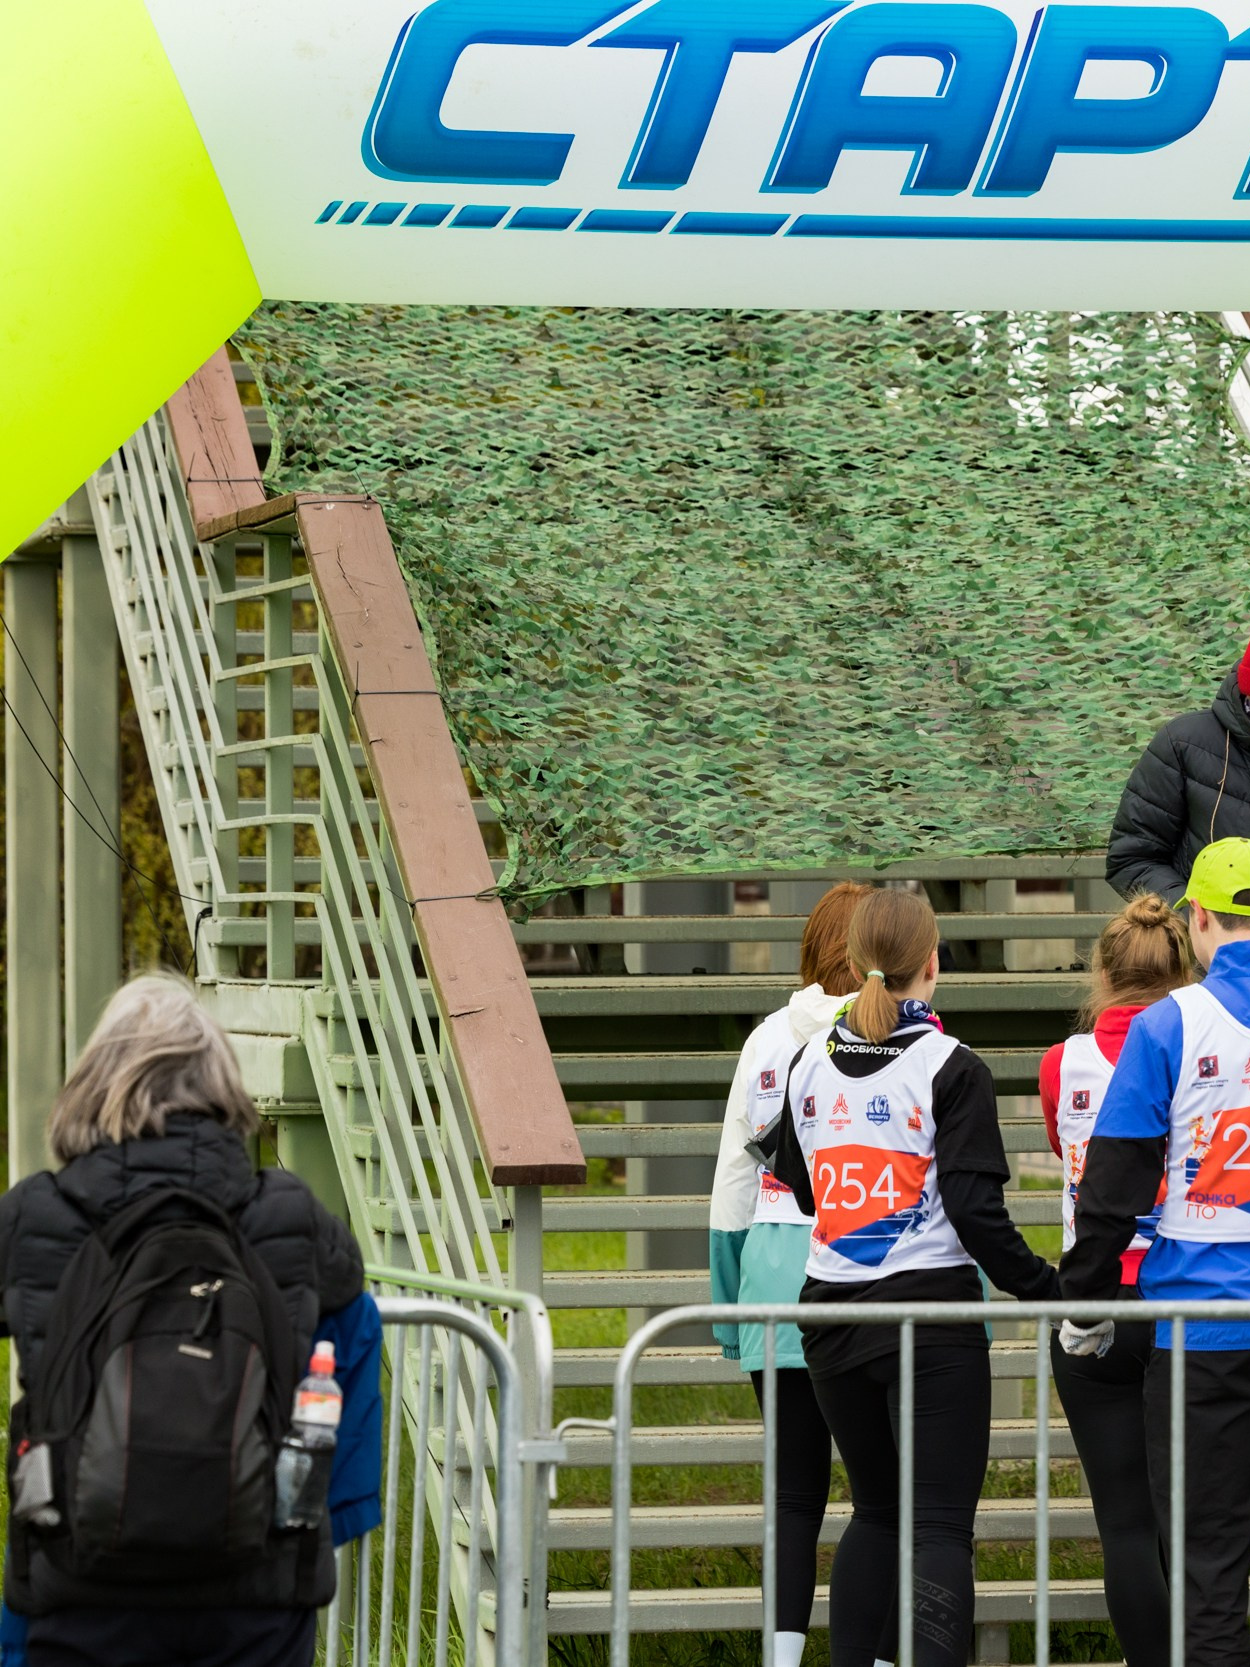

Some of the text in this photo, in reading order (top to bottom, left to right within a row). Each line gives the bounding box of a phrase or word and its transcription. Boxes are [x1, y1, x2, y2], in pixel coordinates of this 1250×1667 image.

[836, 1044, 904, 1056] РОСБИОТЕХ
[818, 1162, 900, 1210] 254
[761, 1190, 780, 1203] ГТО
[1186, 1203, 1217, 1220] ГТО
